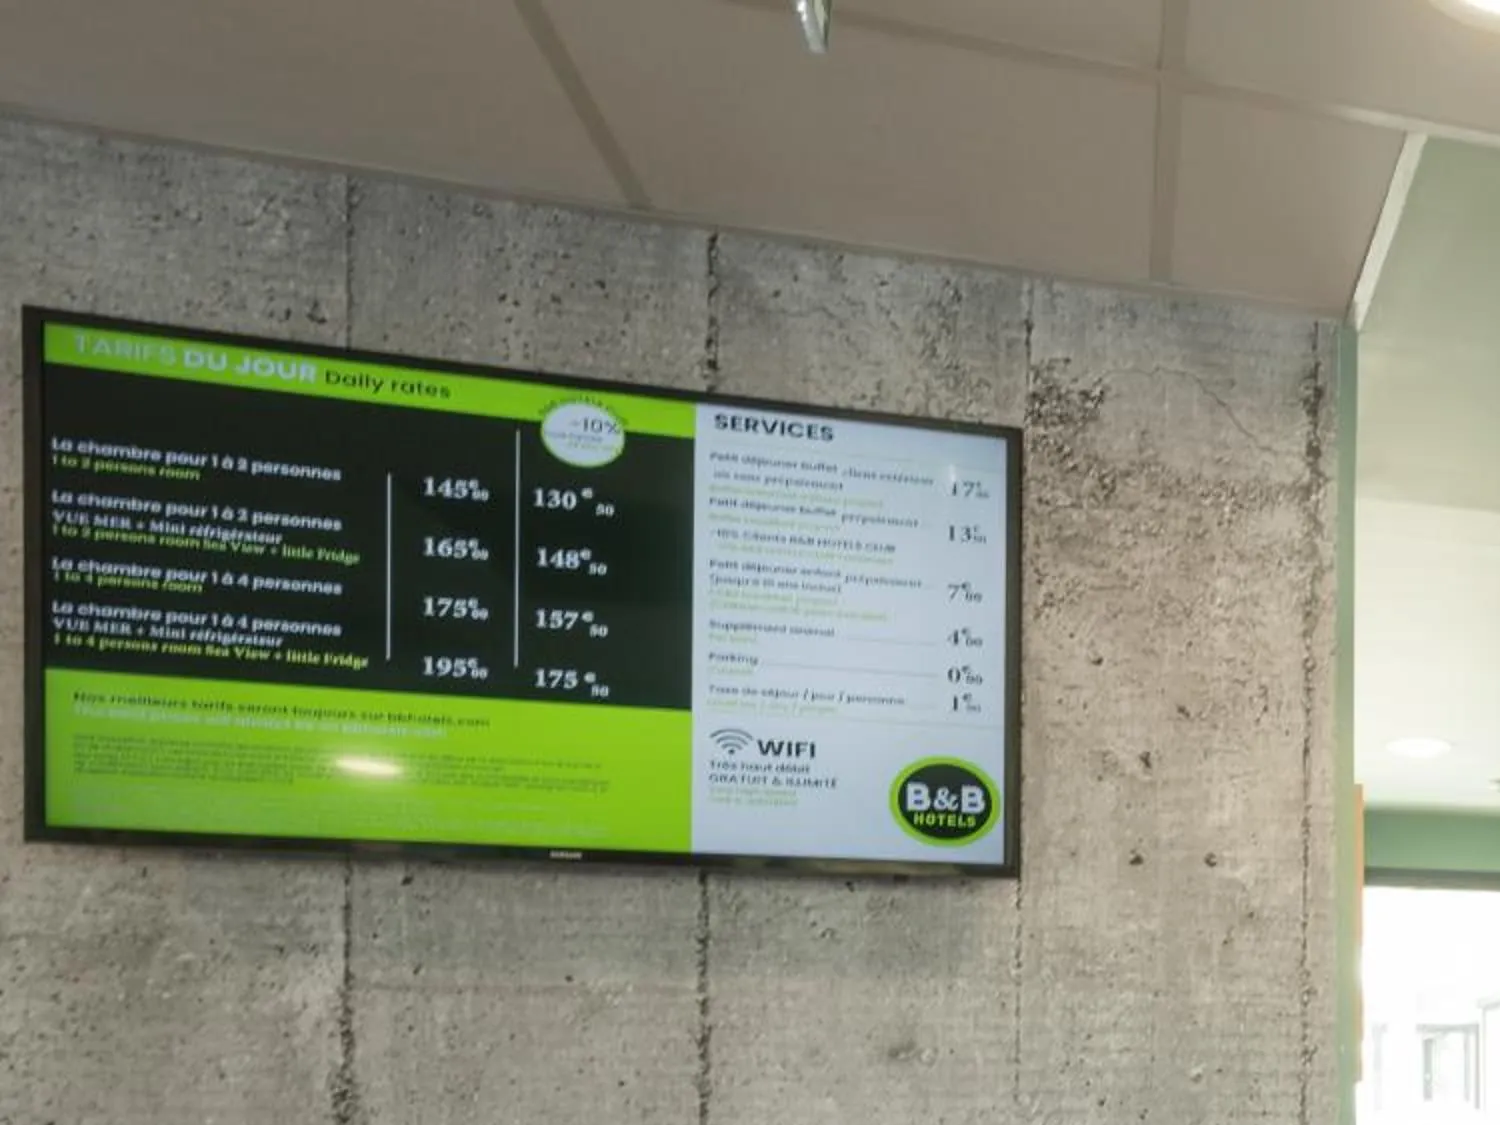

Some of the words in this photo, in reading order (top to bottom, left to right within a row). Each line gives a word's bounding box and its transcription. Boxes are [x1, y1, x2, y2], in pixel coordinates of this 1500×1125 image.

[74, 330, 176, 366] TARIFS
[184, 348, 227, 372] DU
[234, 353, 317, 384] JOUR
[325, 371, 383, 394] Daily
[391, 378, 452, 399] rates
[714, 413, 834, 442] SERVICES
[77, 441, 162, 463] chambre
[166, 452, 208, 469] pour
[251, 460, 342, 481] personnes
[159, 467, 200, 481] room
[77, 493, 162, 514] chambre
[166, 504, 208, 521] pour
[251, 512, 342, 532] personnes
[159, 536, 200, 549] room
[77, 559, 162, 580] chambre
[166, 570, 208, 586] pour
[251, 576, 342, 596] personnes
[77, 602, 162, 622] chambre
[166, 611, 208, 628] pour
[251, 619, 342, 638] personnes
[757, 739, 816, 759] WIFI
[905, 781, 986, 814] B&B
[913, 812, 977, 829] HOTELS
